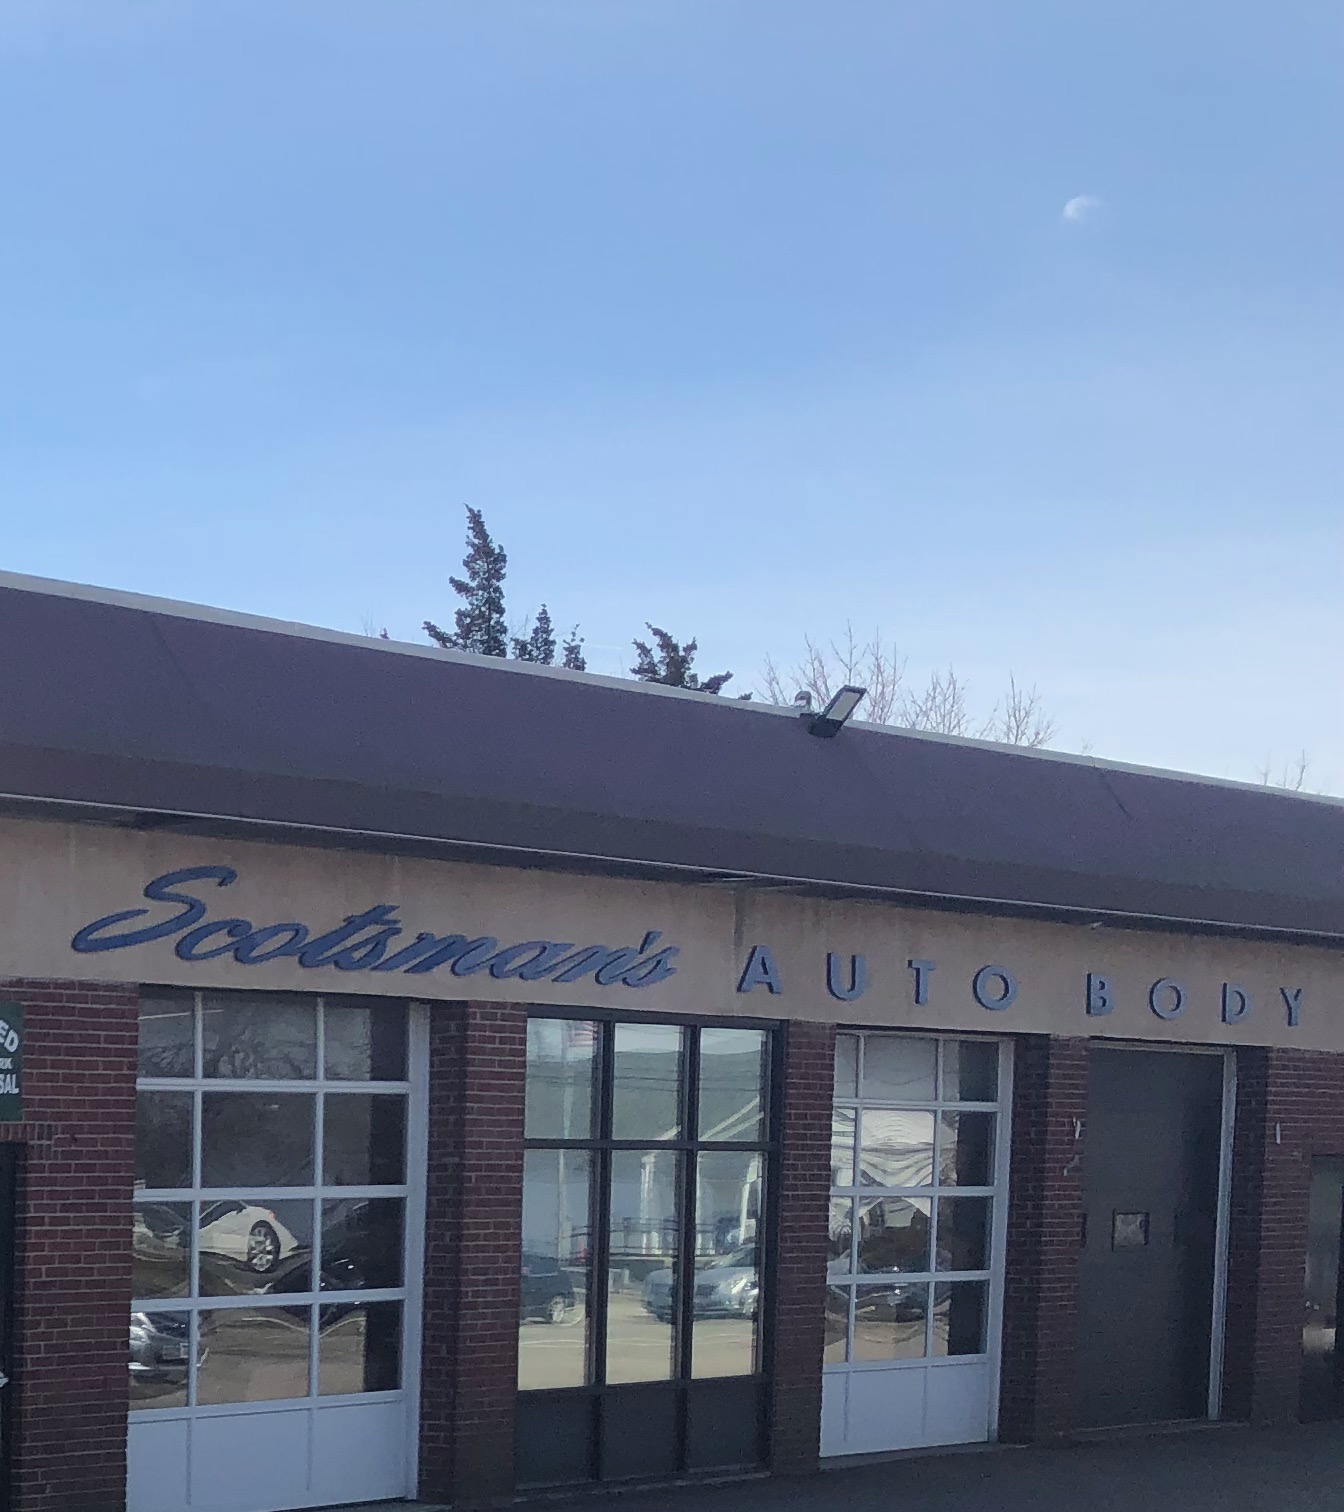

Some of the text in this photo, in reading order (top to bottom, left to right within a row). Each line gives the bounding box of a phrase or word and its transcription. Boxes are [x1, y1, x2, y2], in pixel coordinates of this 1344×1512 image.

[71, 865, 1309, 1027] Scotsman's AUTO BODY
